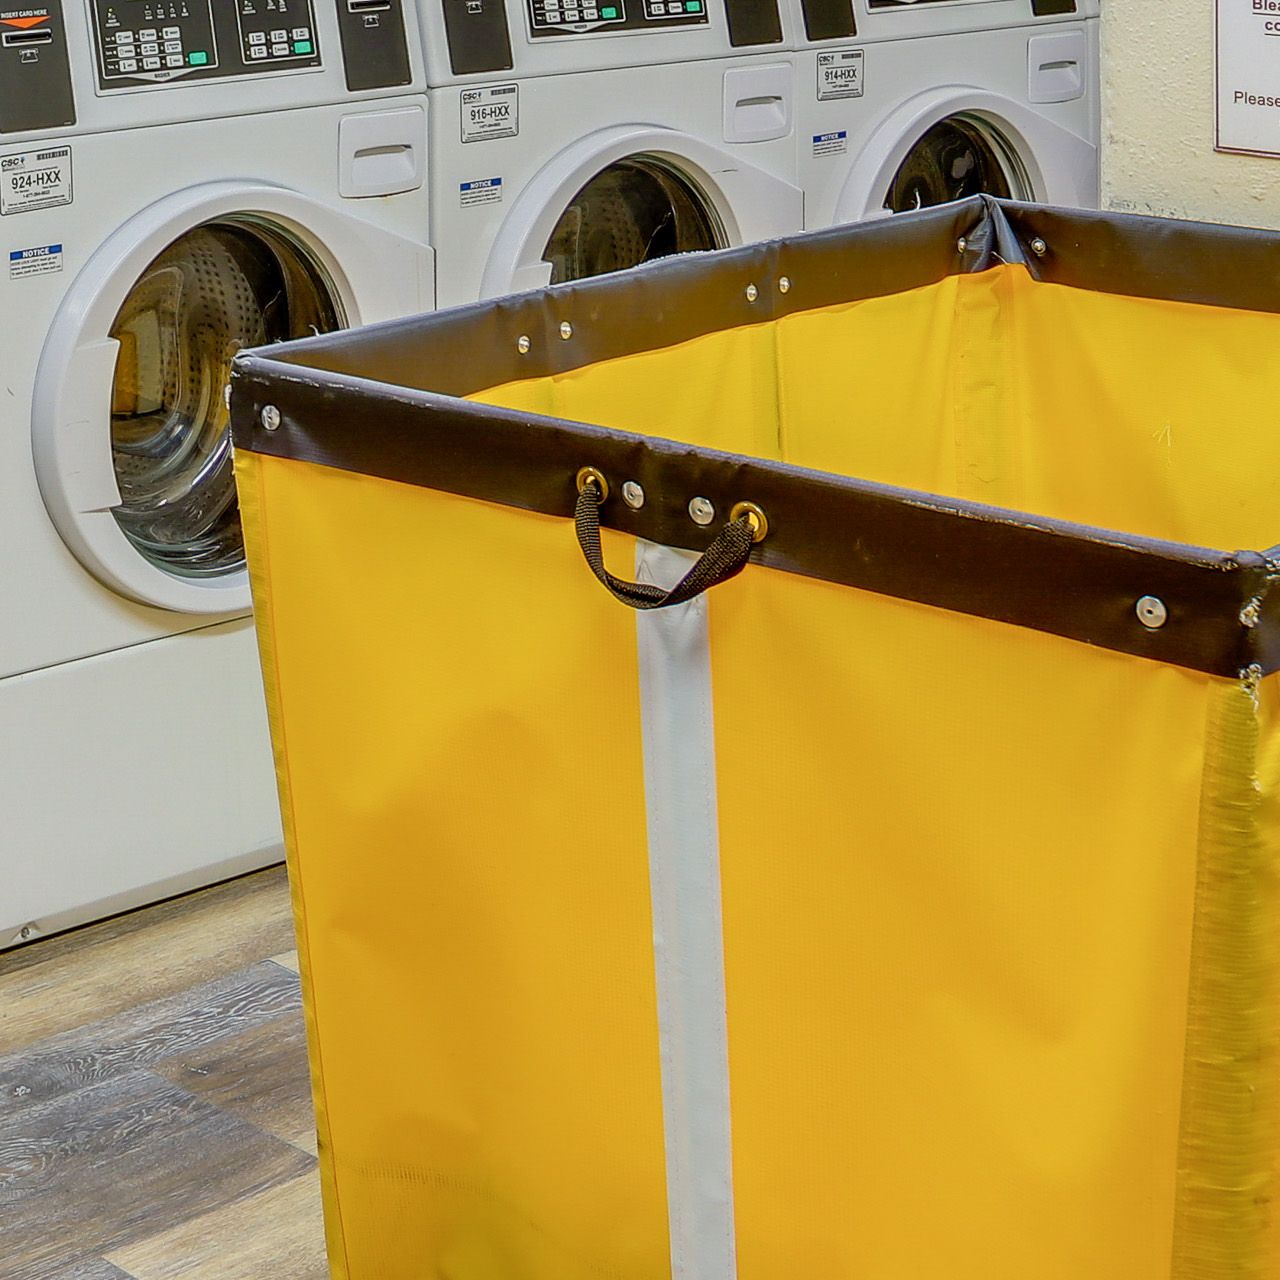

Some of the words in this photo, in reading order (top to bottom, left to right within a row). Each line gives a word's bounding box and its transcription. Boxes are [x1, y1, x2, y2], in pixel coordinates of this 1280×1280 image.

[825, 69, 856, 80] 914-HXX
[471, 105, 510, 120] 916-HXX
[1, 158, 19, 167] CSC
[12, 170, 61, 190] 924-HXX
[22, 247, 50, 258] NOTICE
